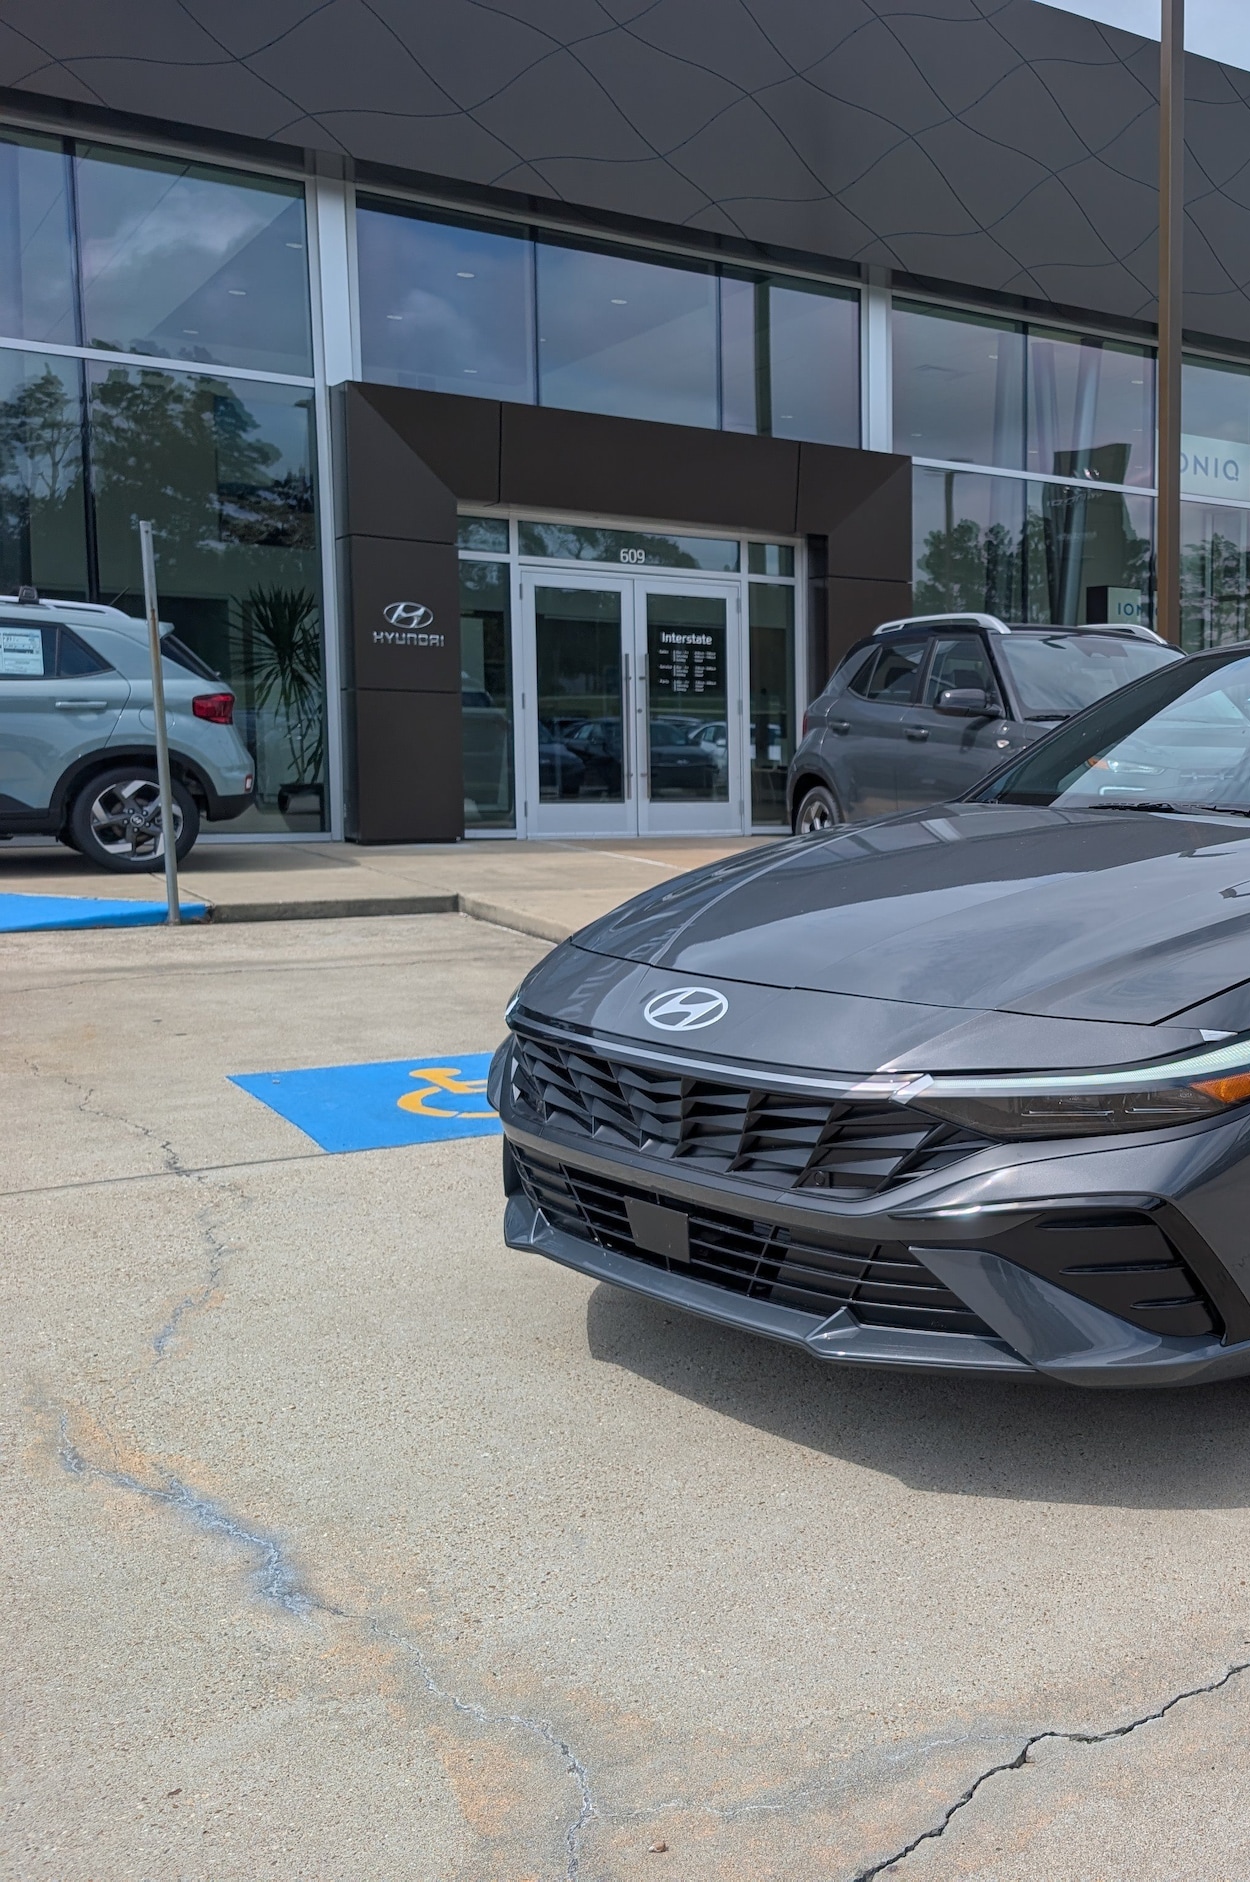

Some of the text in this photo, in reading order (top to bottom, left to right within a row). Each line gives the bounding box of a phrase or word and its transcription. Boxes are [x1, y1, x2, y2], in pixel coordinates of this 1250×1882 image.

[620, 548, 646, 564] 609
[372, 630, 445, 647] HYUNDAI
[661, 631, 713, 646] Interstate
